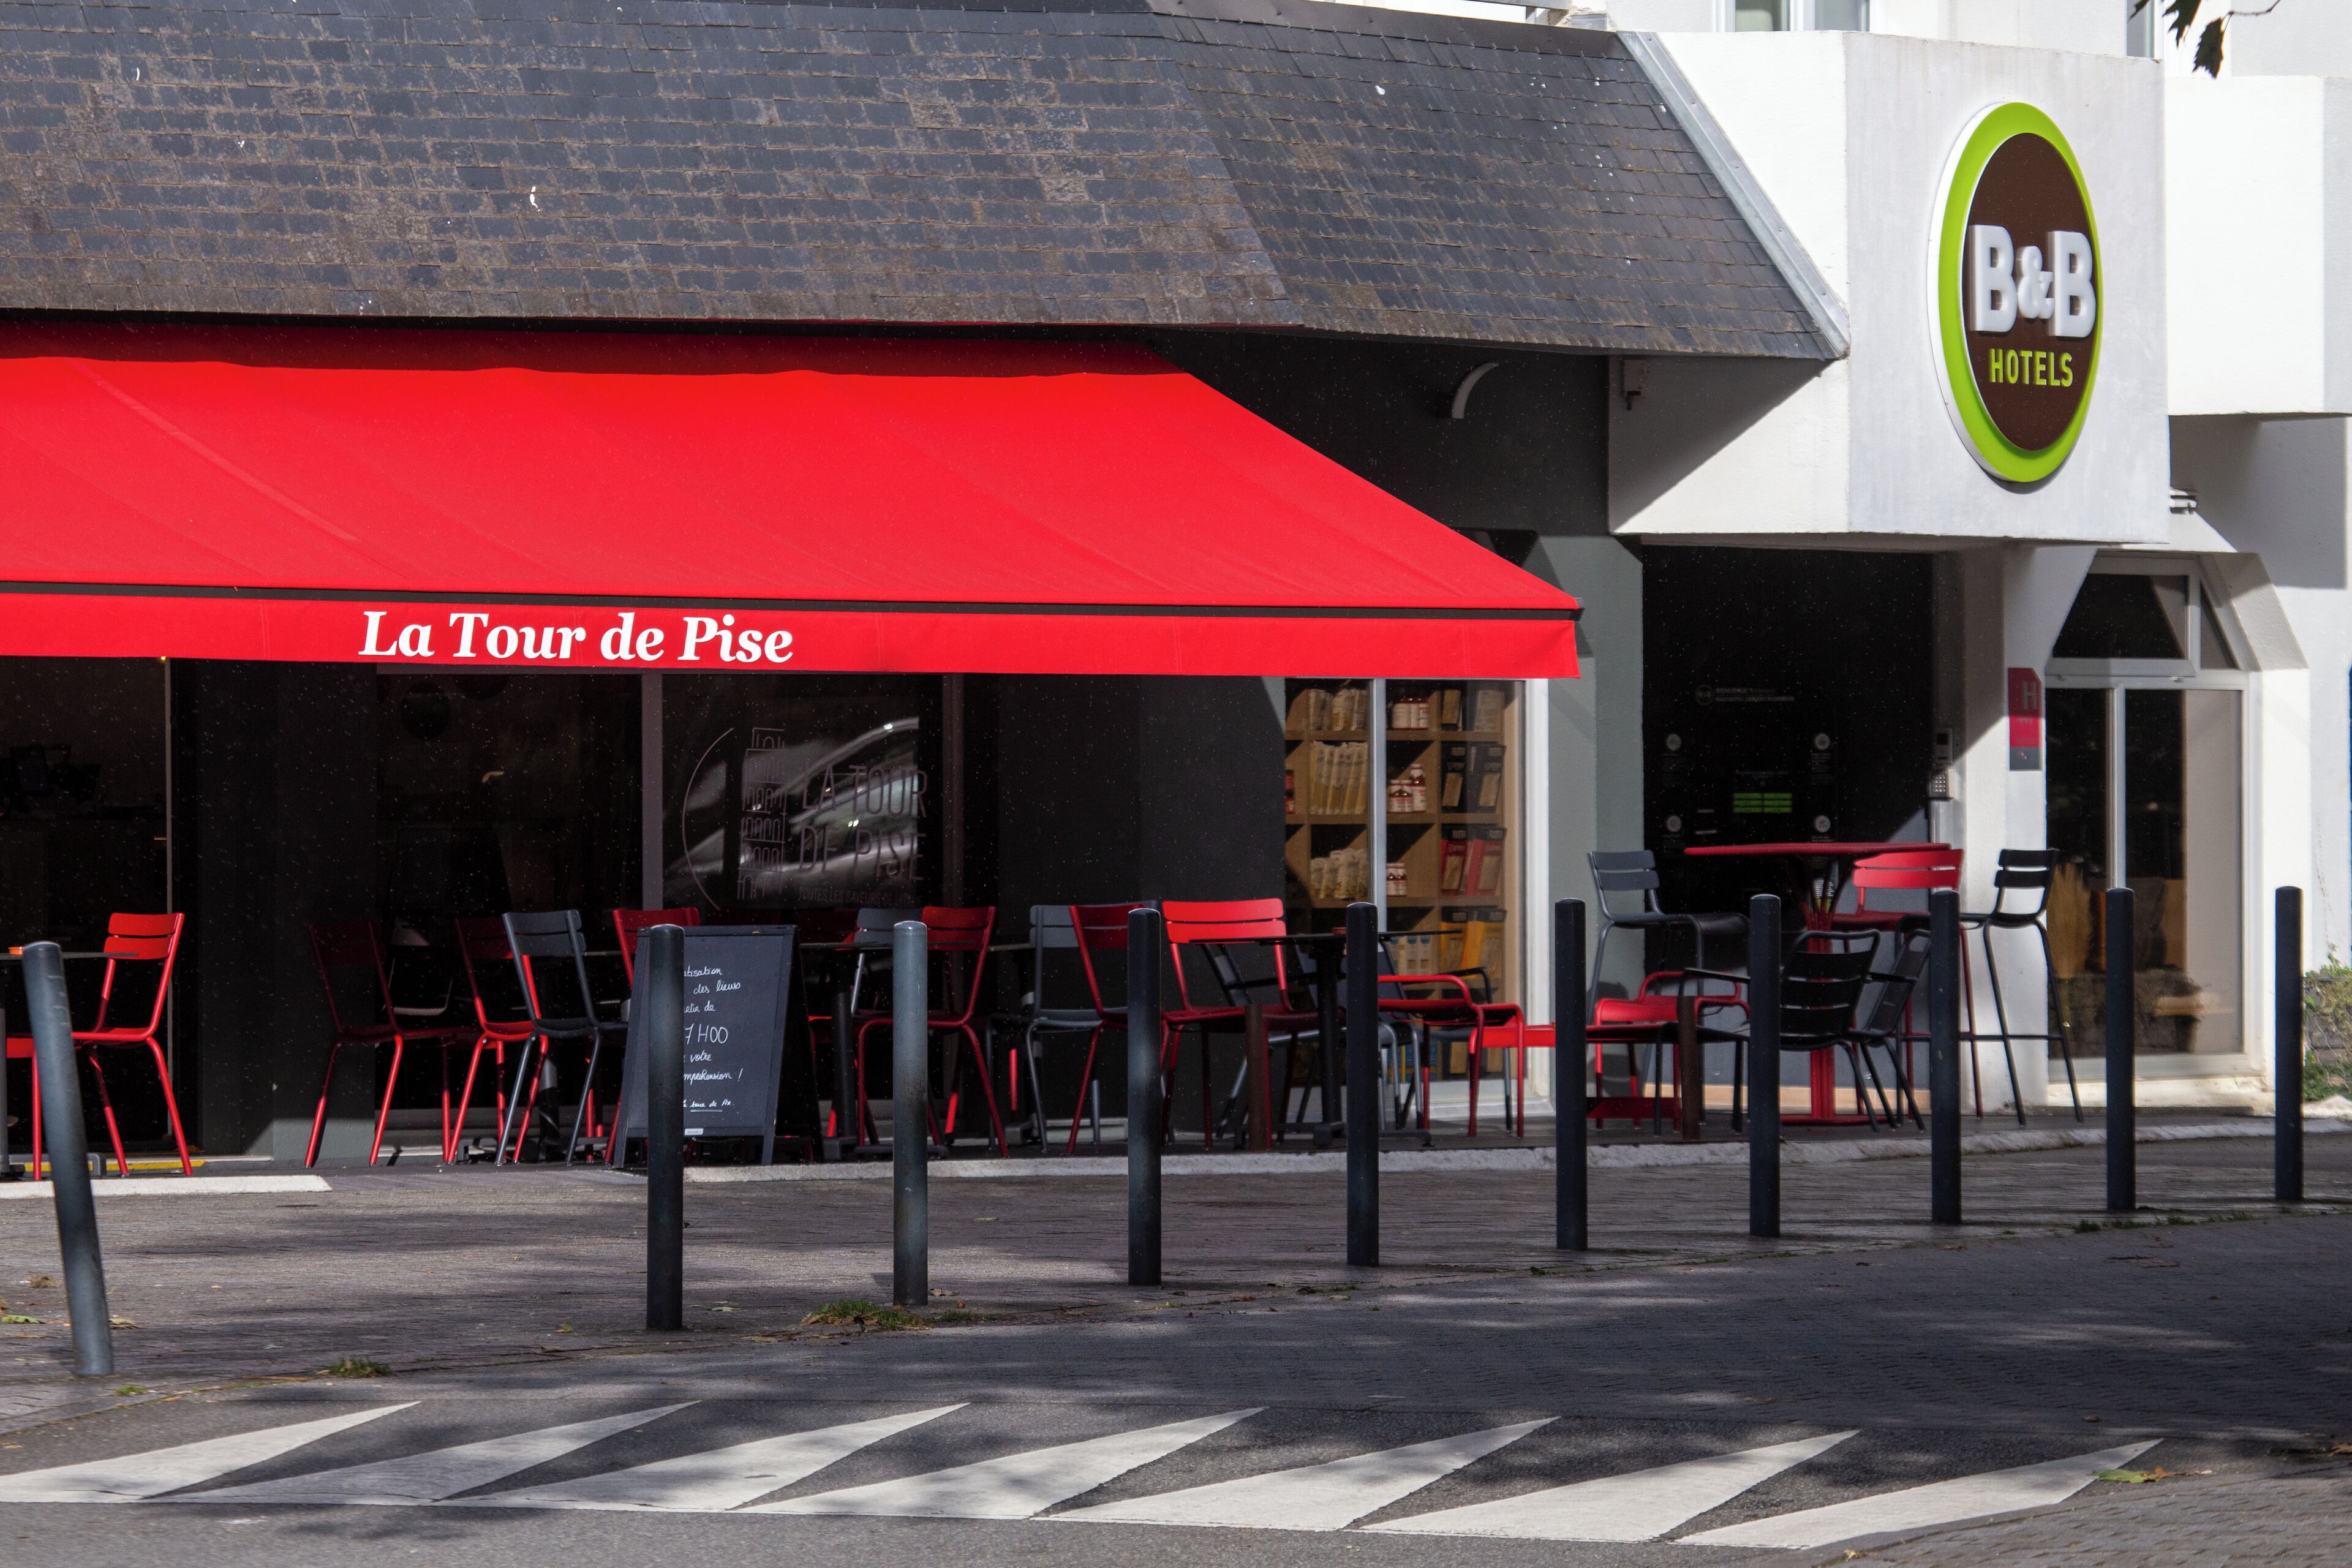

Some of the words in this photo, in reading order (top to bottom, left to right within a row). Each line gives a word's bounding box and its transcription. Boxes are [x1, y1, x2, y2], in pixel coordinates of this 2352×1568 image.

[1967, 224, 2097, 338] B&B
[1989, 348, 2073, 387] HOTELS
[358, 611, 434, 657] La
[449, 612, 586, 660] Tour
[600, 611, 665, 662] de
[677, 613, 794, 663] Pise
[802, 762, 837, 811] LA
[849, 764, 929, 818] TOUR
[799, 824, 839, 873] DE
[853, 828, 927, 881] PISE
[693, 984, 710, 995] des
[704, 1000, 716, 1012] de
[690, 1049, 712, 1063] votre
